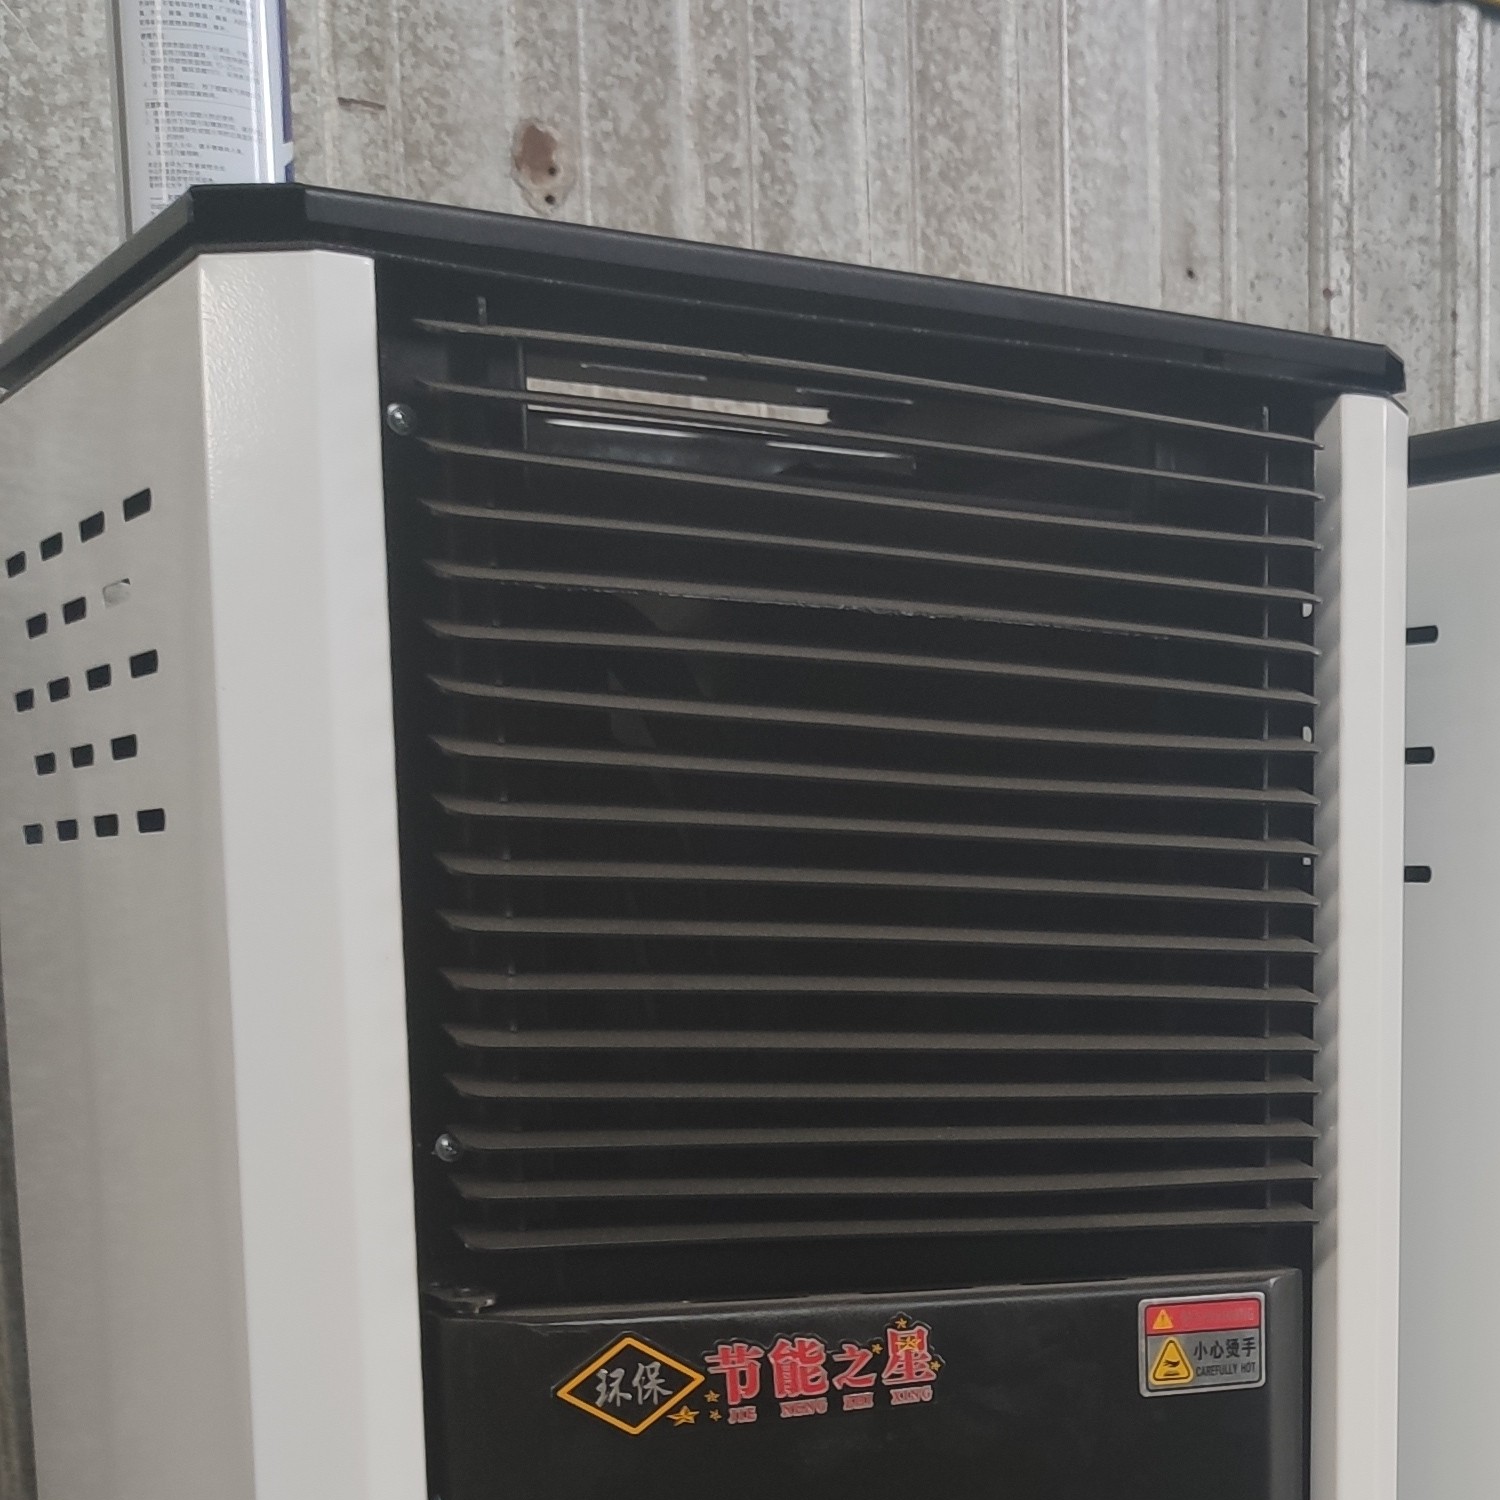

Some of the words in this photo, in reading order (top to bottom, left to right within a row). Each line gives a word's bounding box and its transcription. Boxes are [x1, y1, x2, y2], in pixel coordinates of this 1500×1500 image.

[704, 1325, 938, 1406] 节能之星
[1193, 1336, 1257, 1361] 小心烫手
[594, 1360, 674, 1408] 环保
[1195, 1363, 1238, 1378] CAREFULLY
[1240, 1361, 1256, 1375] HOT
